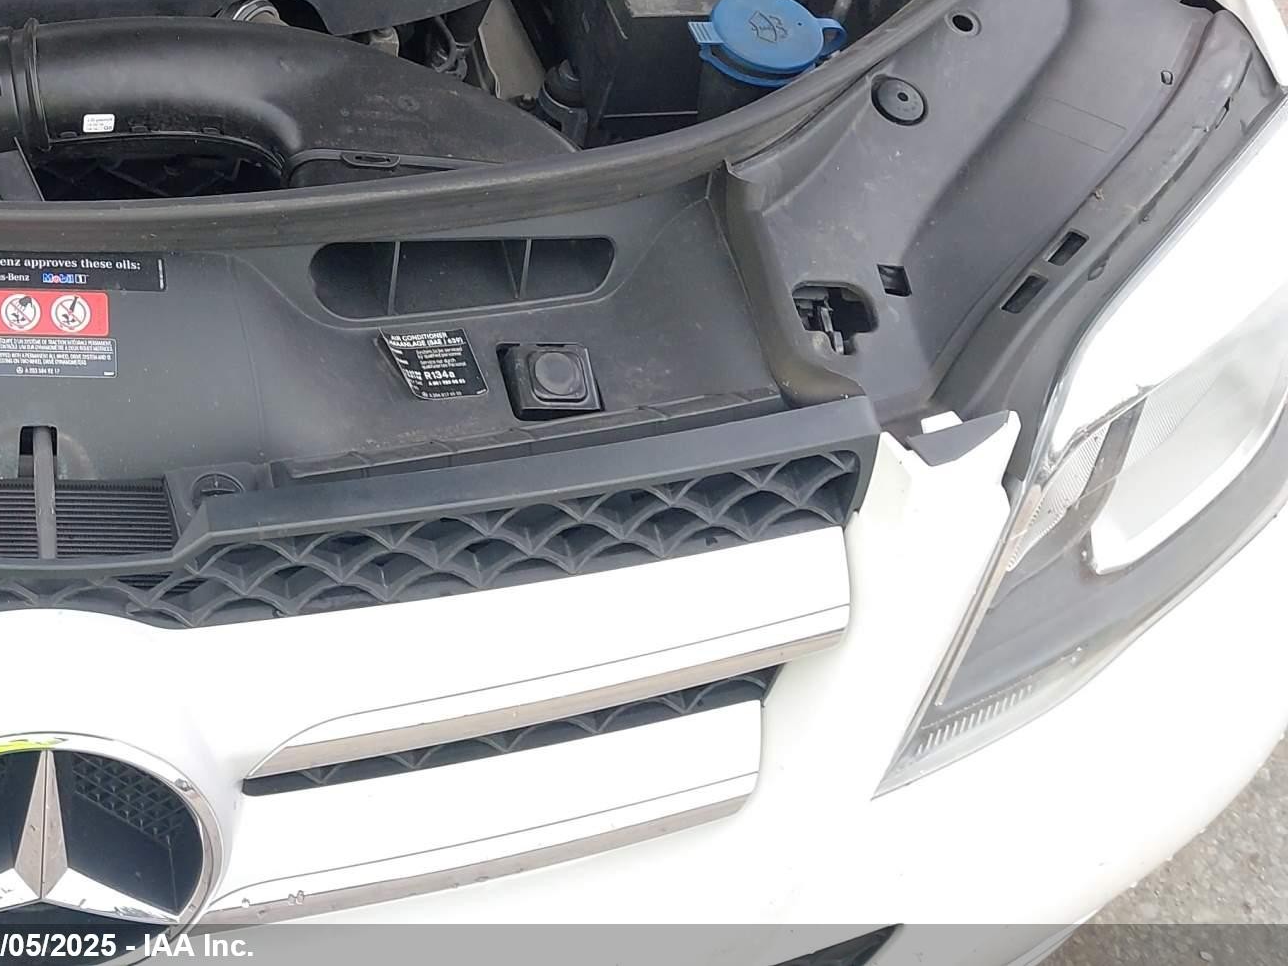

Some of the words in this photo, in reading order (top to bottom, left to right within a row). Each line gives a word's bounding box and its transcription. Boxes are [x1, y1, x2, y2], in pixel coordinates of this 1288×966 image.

[23, 259, 78, 270] approves
[80, 258, 112, 269] these
[114, 259, 141, 270] oils:
[42, 273, 73, 284] Mobil
[423, 370, 456, 380] R134a
